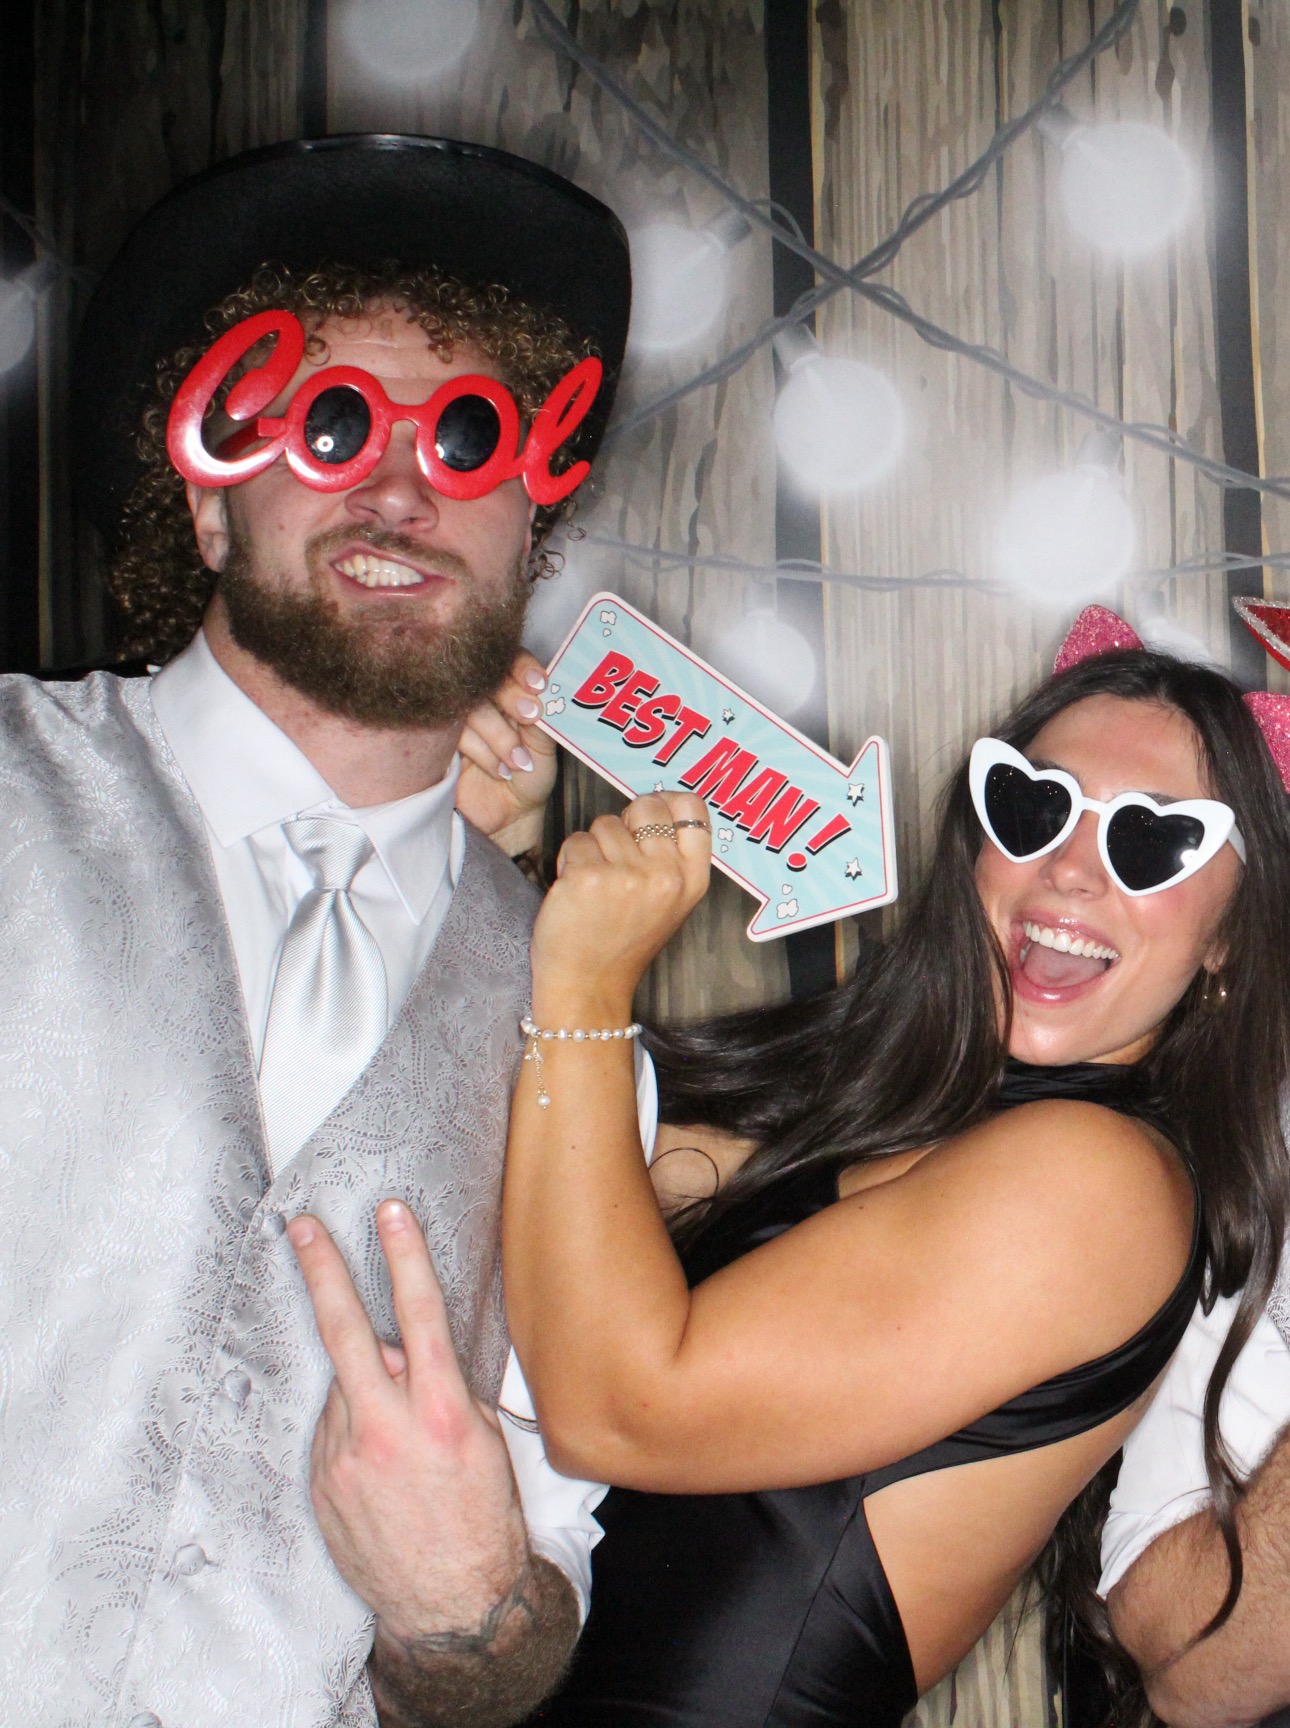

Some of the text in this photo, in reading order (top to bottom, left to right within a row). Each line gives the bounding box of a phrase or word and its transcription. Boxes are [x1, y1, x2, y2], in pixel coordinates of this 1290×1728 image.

[166, 309, 602, 506] Cool
[571, 649, 852, 873] BEST MAN!
